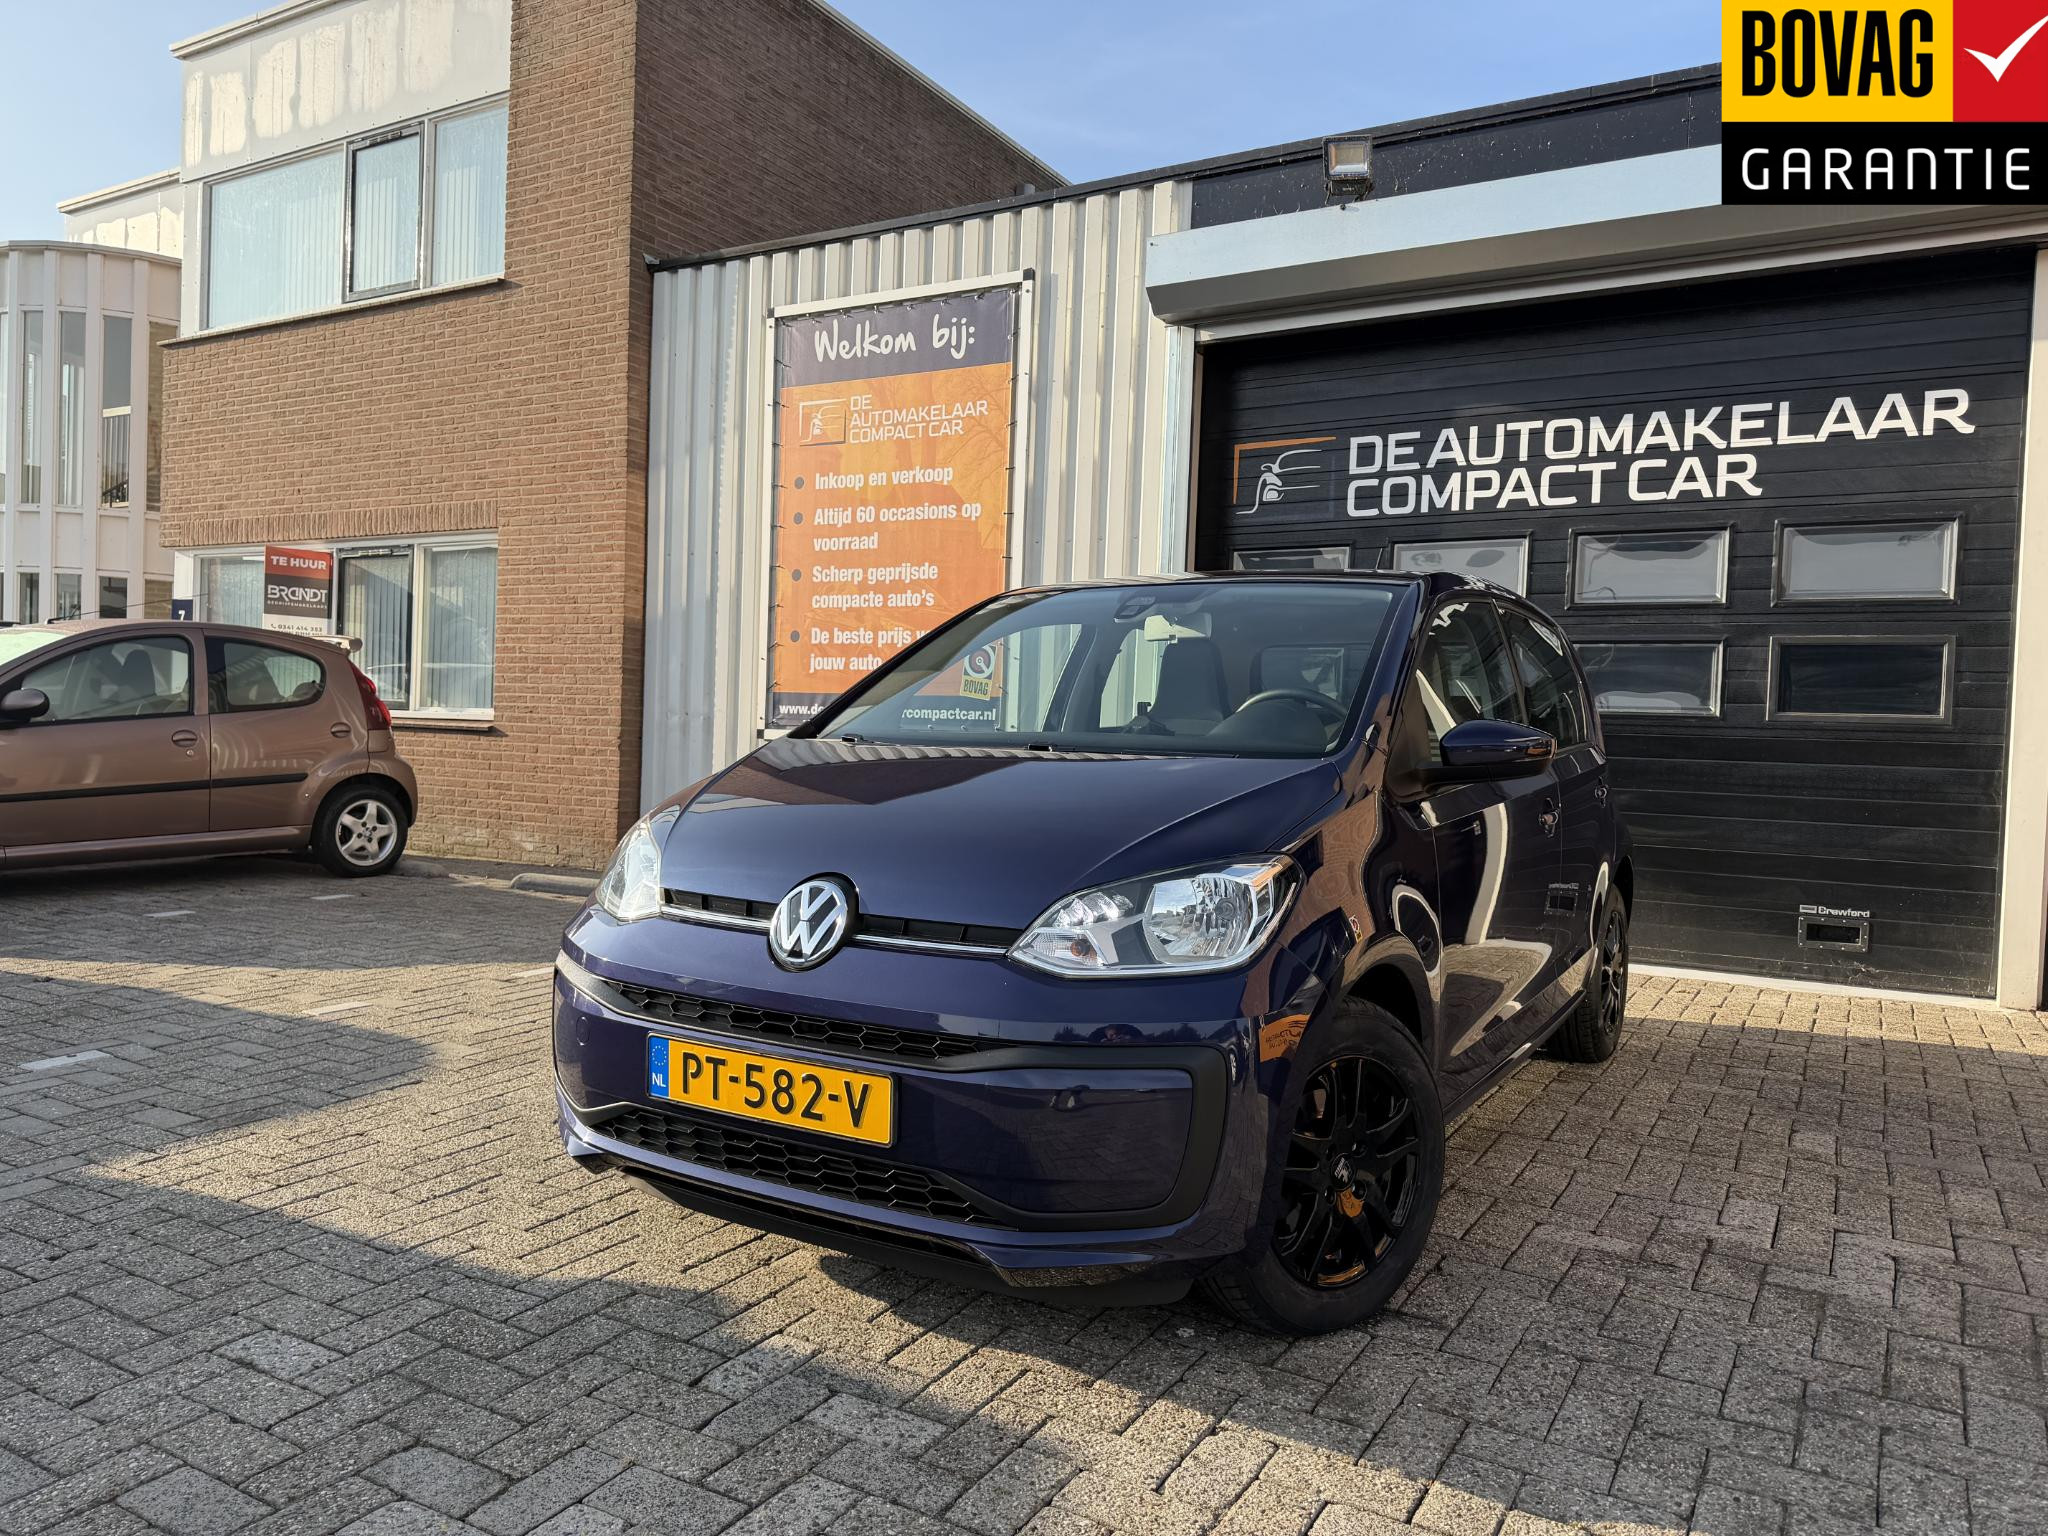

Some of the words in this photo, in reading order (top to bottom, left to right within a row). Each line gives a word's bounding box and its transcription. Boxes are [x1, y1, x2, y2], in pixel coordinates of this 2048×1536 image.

[814, 318, 916, 362] Welkom
[932, 313, 976, 360] bij:
[850, 395, 872, 411] DE
[850, 400, 988, 427] AUTOMAKELAAR
[850, 423, 926, 444] COMPACT
[929, 420, 964, 436] CAR
[1349, 431, 1421, 475] DE
[1425, 388, 1975, 468] AUTOMAKELAAR
[815, 471, 865, 490] Inkoop
[869, 472, 886, 486] en
[892, 467, 953, 486] verkoop
[1347, 462, 1617, 517] COMPACT
[1628, 453, 1763, 501] CAR
[814, 507, 851, 527] Altijd
[856, 506, 875, 522] 60
[879, 503, 957, 521] occasions
[961, 503, 981, 521] op
[813, 532, 879, 551] voorraad
[270, 555, 287, 566] TE
[290, 557, 327, 570] HUUR
[812, 565, 863, 584] Scherp
[867, 562, 938, 584] geprijsde
[267, 585, 328, 603] BRANDT
[812, 591, 883, 610] compacte
[887, 589, 935, 607] auto's
[178, 610, 185, 621] 7
[811, 627, 829, 644] De
[833, 627, 873, 644] beste
[878, 627, 912, 647] prijs
[809, 653, 846, 673] jouw
[963, 680, 989, 695] BOVAG
[1818, 906, 1870, 918] Crawford
[652, 1072, 667, 1088] NL
[682, 1051, 872, 1128] PT-582-V
